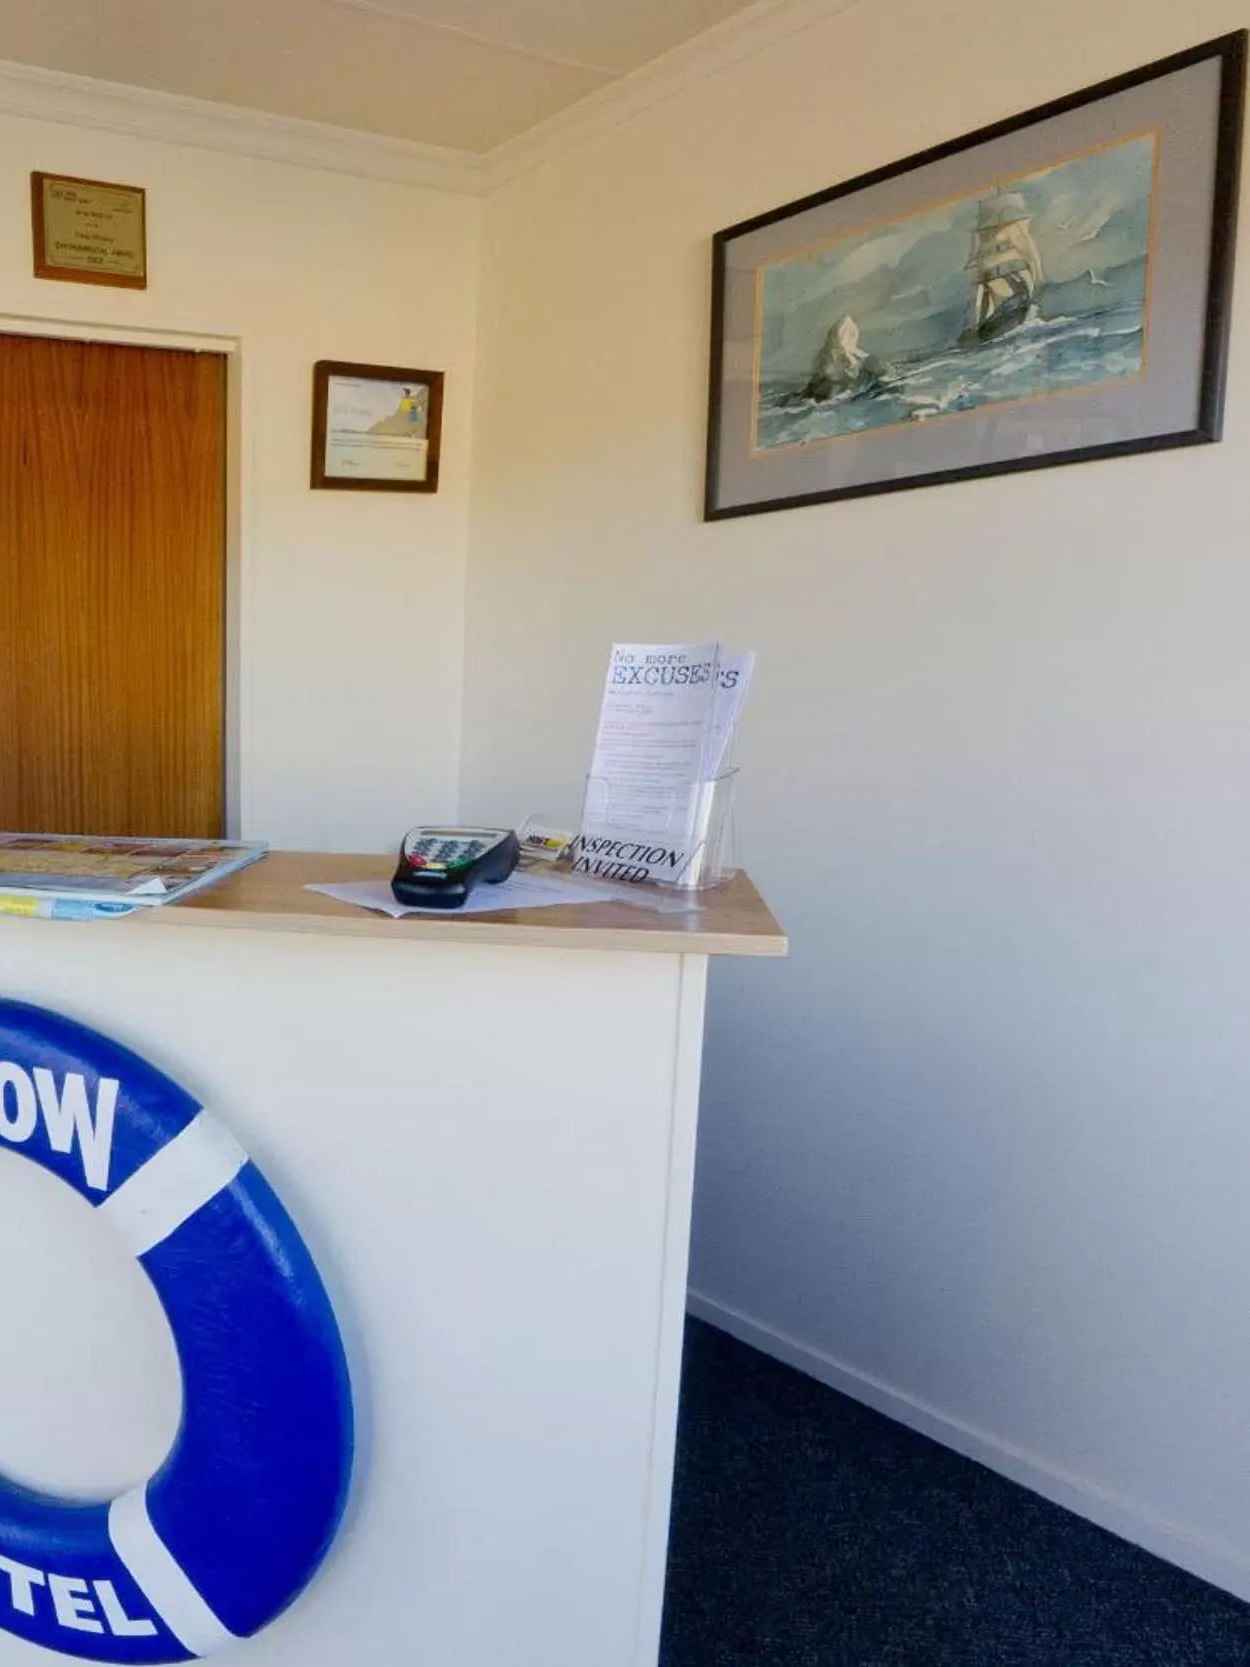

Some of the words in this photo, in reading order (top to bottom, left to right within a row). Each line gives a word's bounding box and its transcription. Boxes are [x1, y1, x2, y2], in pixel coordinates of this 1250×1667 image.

[614, 649, 635, 663] No
[645, 653, 687, 664] more
[612, 662, 711, 685] EXCUSES
[570, 835, 684, 867] INSPECTION
[571, 857, 649, 884] INVITED
